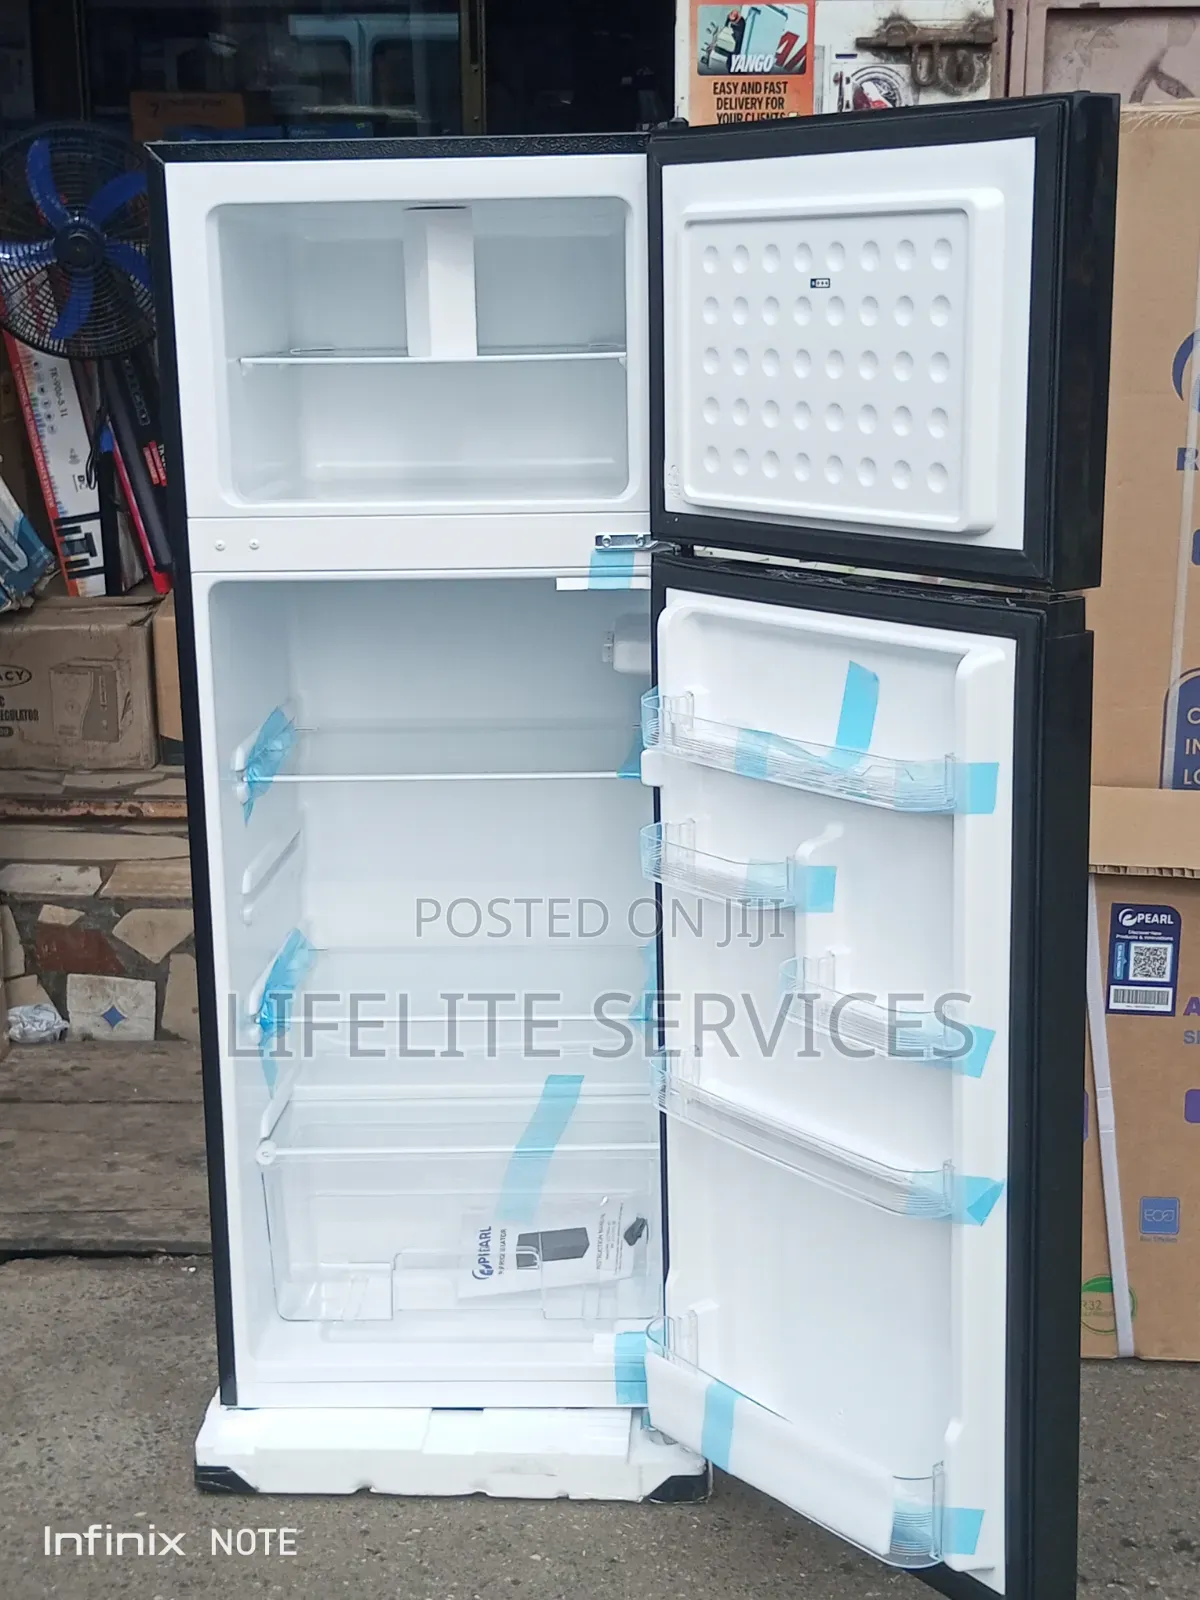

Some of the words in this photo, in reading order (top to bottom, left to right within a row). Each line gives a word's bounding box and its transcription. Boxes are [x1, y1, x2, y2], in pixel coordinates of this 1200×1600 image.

[730, 54, 775, 73] YANGO
[713, 82, 739, 95] EASY
[741, 82, 762, 95] AND
[764, 81, 788, 94] FAST
[716, 97, 765, 110] DELIVERY
[765, 97, 784, 110] FOR
